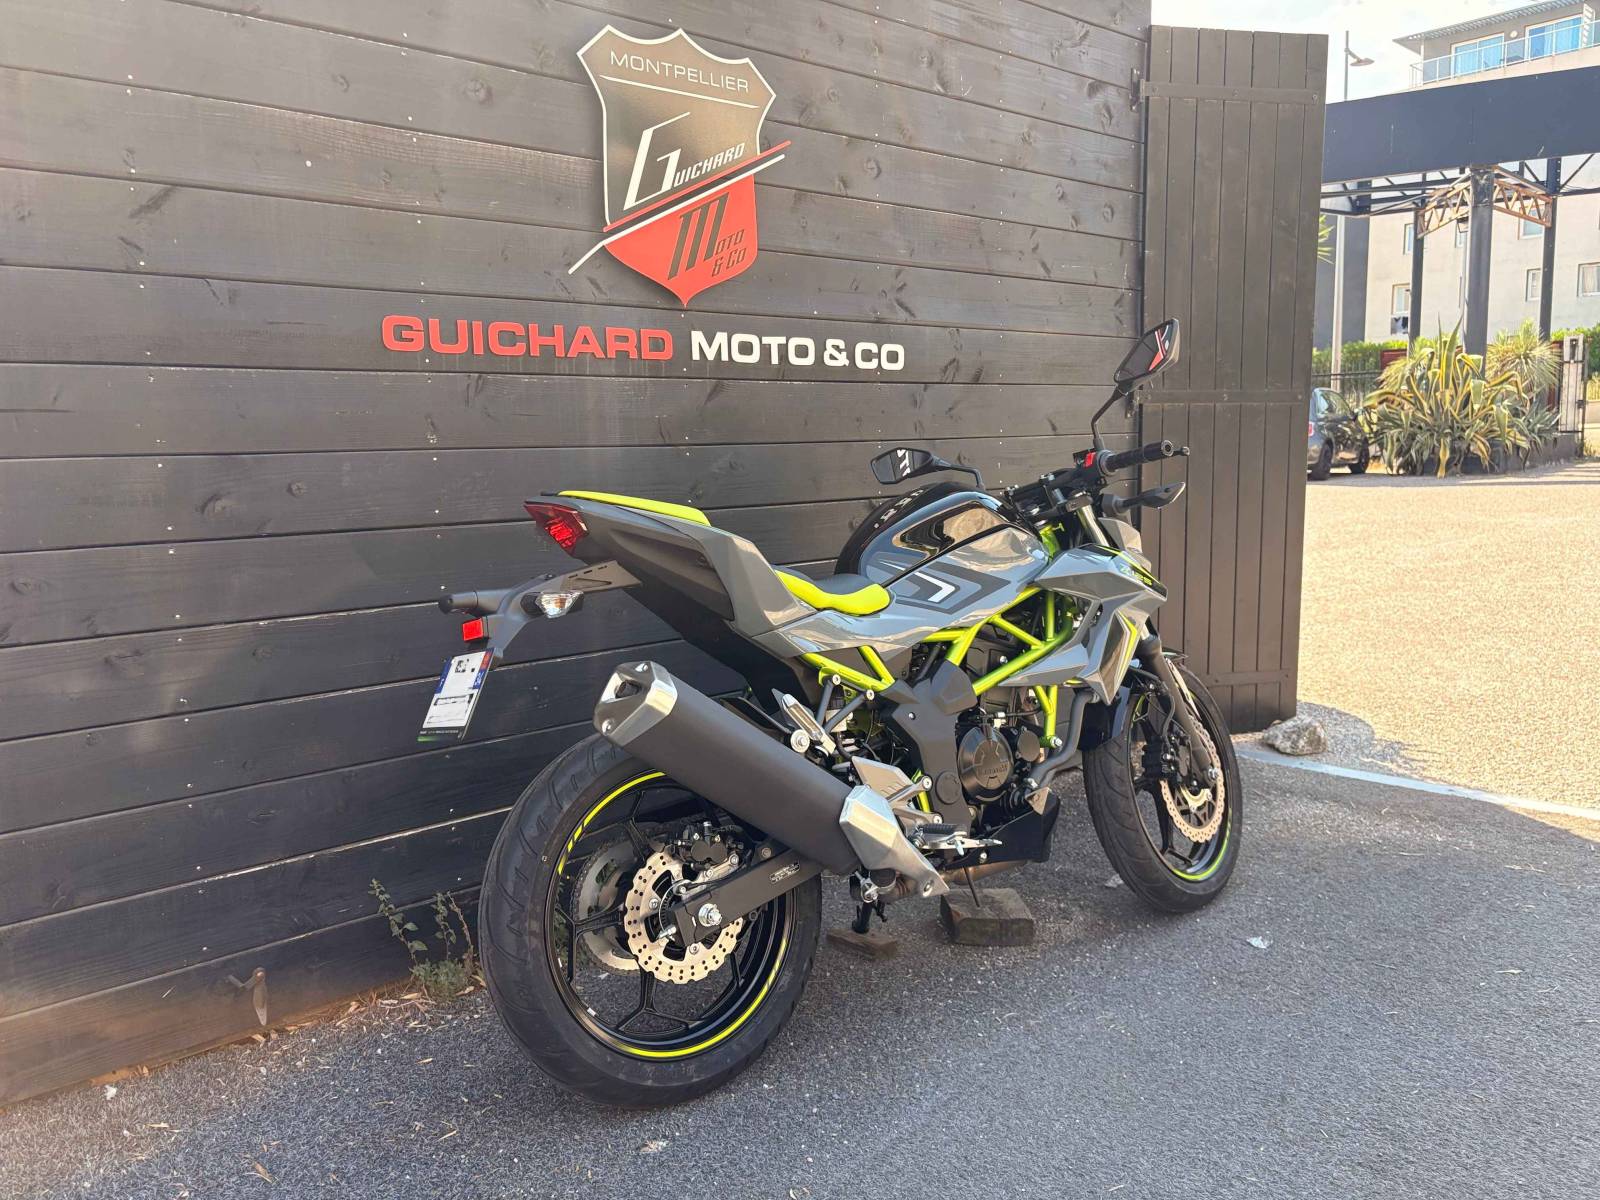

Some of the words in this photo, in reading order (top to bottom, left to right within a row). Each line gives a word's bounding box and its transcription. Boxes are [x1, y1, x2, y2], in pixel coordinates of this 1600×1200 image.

[610, 50, 749, 93] MONTPELLIER
[623, 111, 746, 211] GUICHARD
[667, 191, 745, 280] MOTO
[382, 315, 673, 360] GUICHARD
